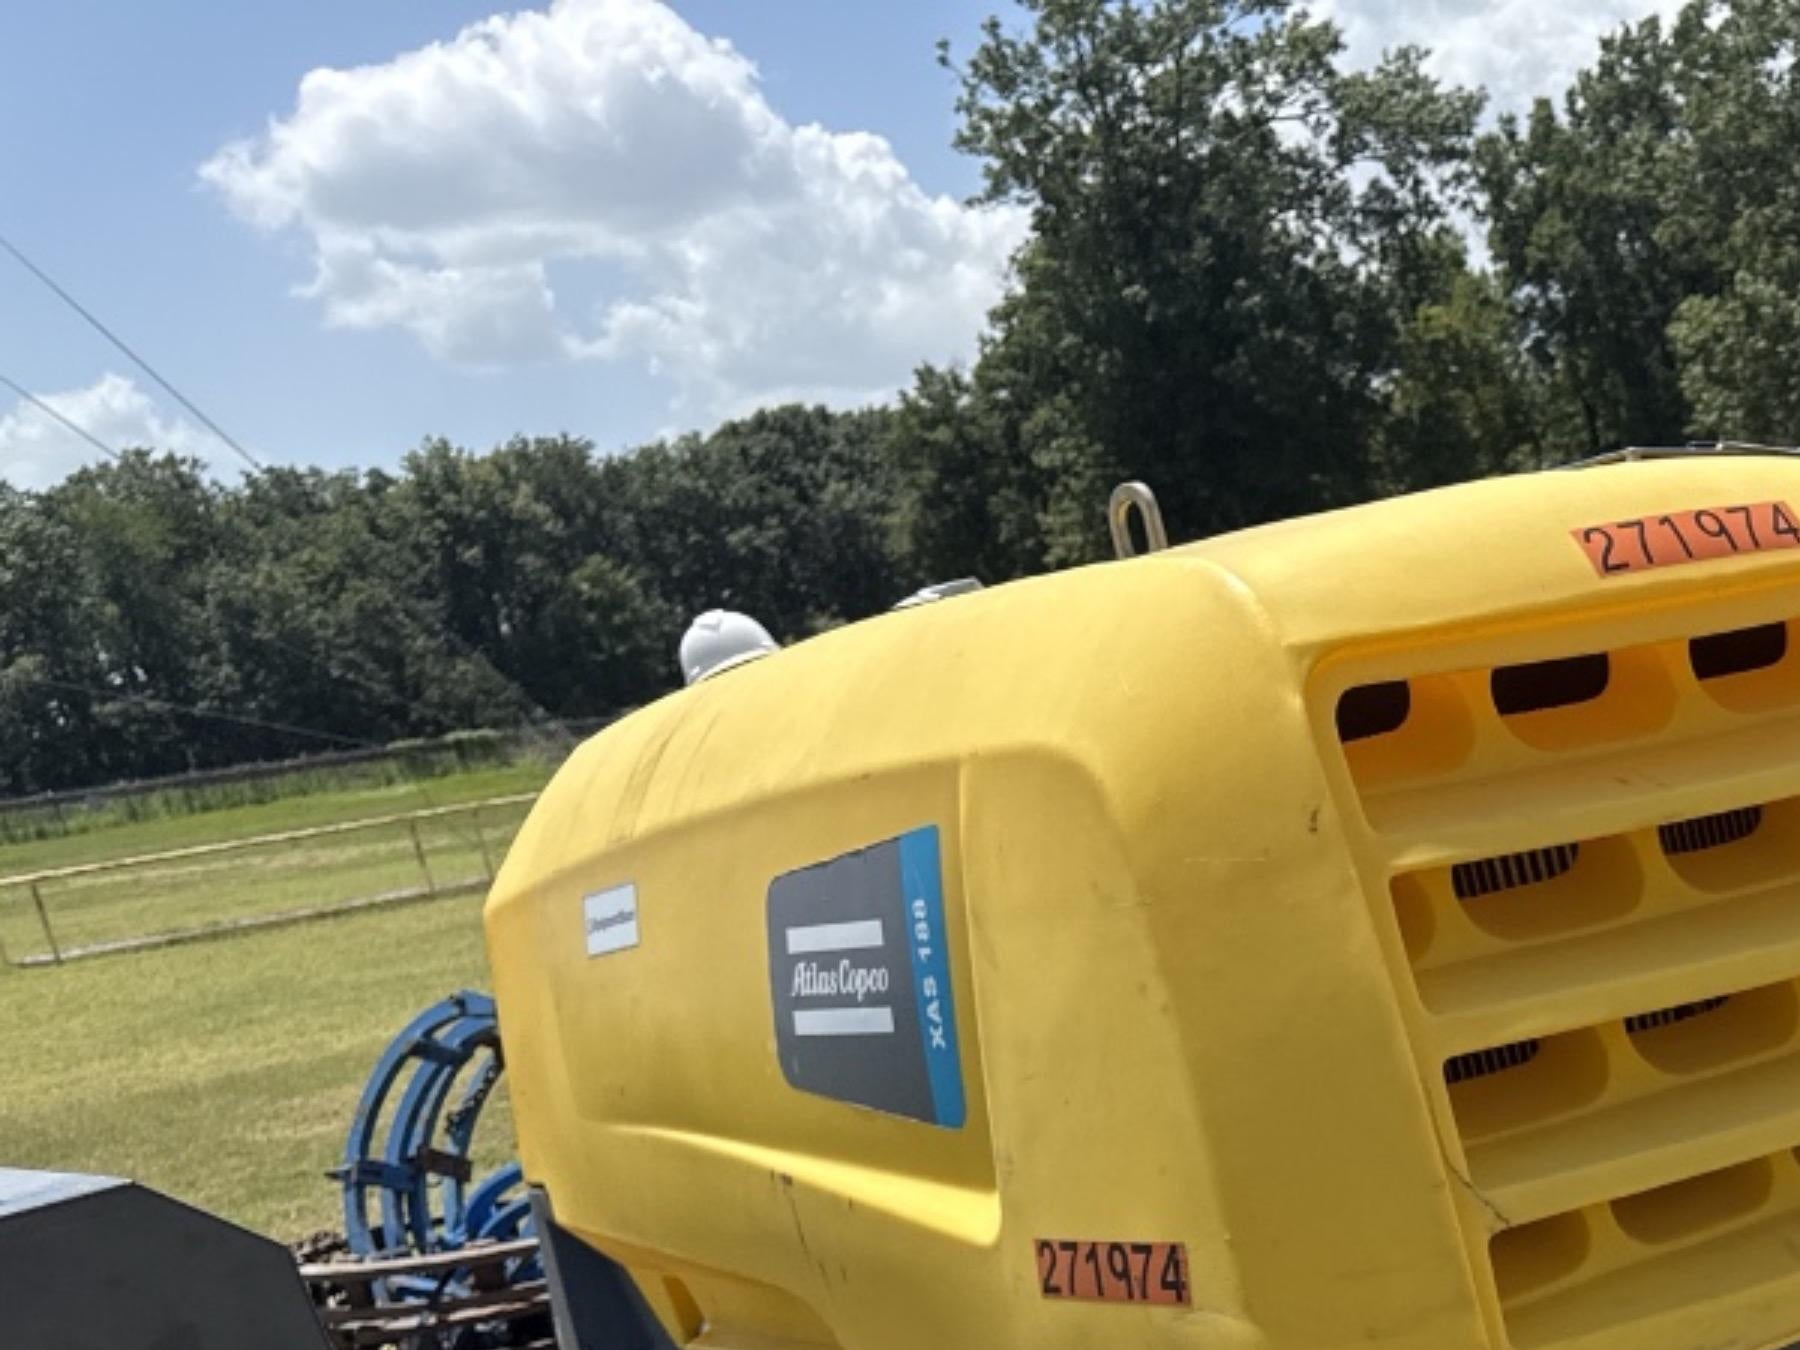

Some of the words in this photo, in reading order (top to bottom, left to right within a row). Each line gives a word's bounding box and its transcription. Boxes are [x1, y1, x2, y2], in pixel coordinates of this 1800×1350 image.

[790, 962, 838, 998] Atlas
[838, 958, 890, 1003] Copco
[922, 975, 946, 1049] XAS
[1038, 1240, 1187, 1303] 271974
